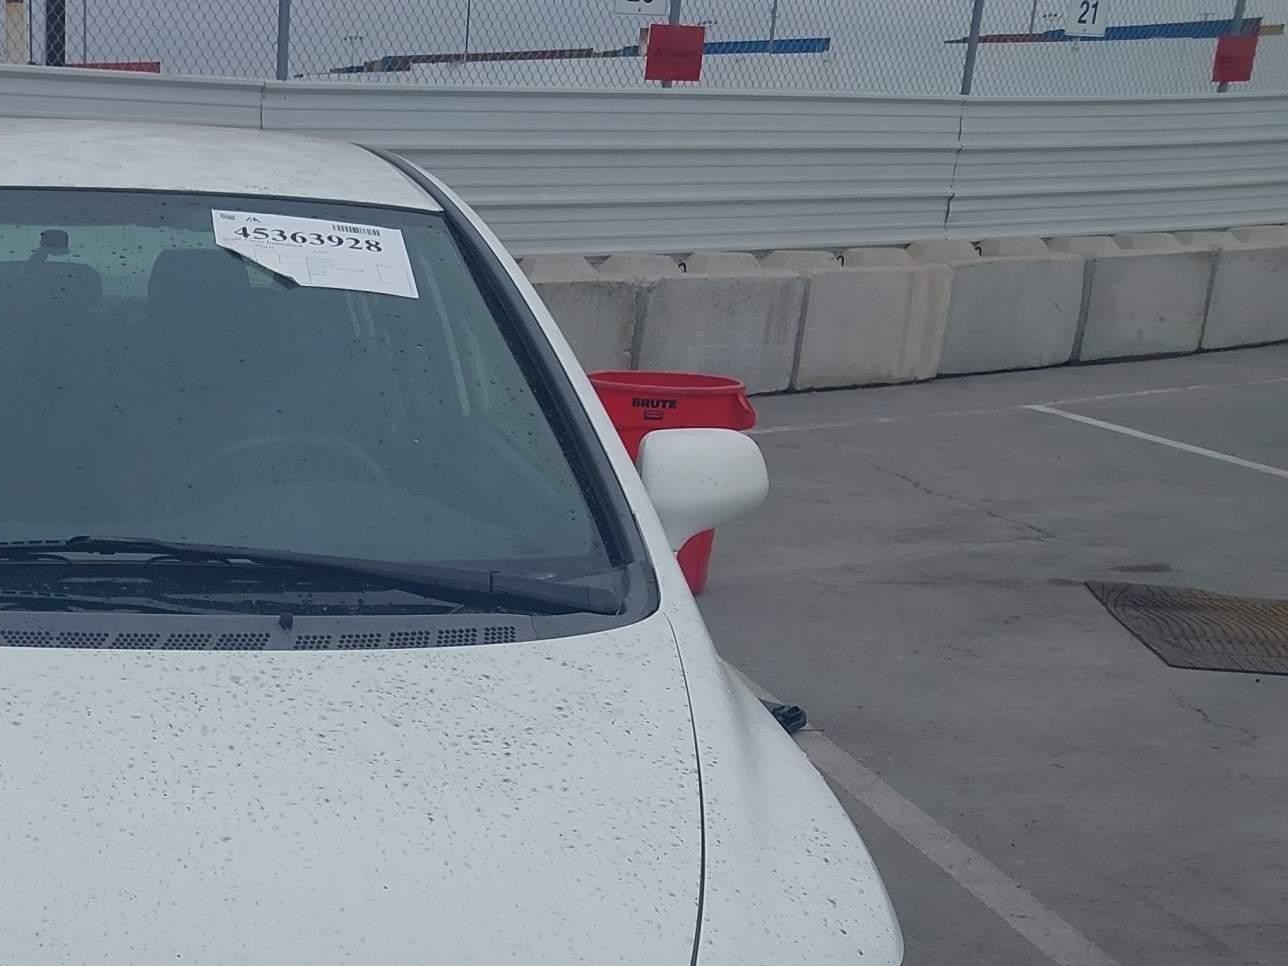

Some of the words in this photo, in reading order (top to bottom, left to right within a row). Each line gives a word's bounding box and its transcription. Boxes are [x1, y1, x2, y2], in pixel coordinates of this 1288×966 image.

[1077, 0, 1099, 24] 21
[233, 226, 383, 254] 45363928
[632, 398, 678, 409] BRUTE
